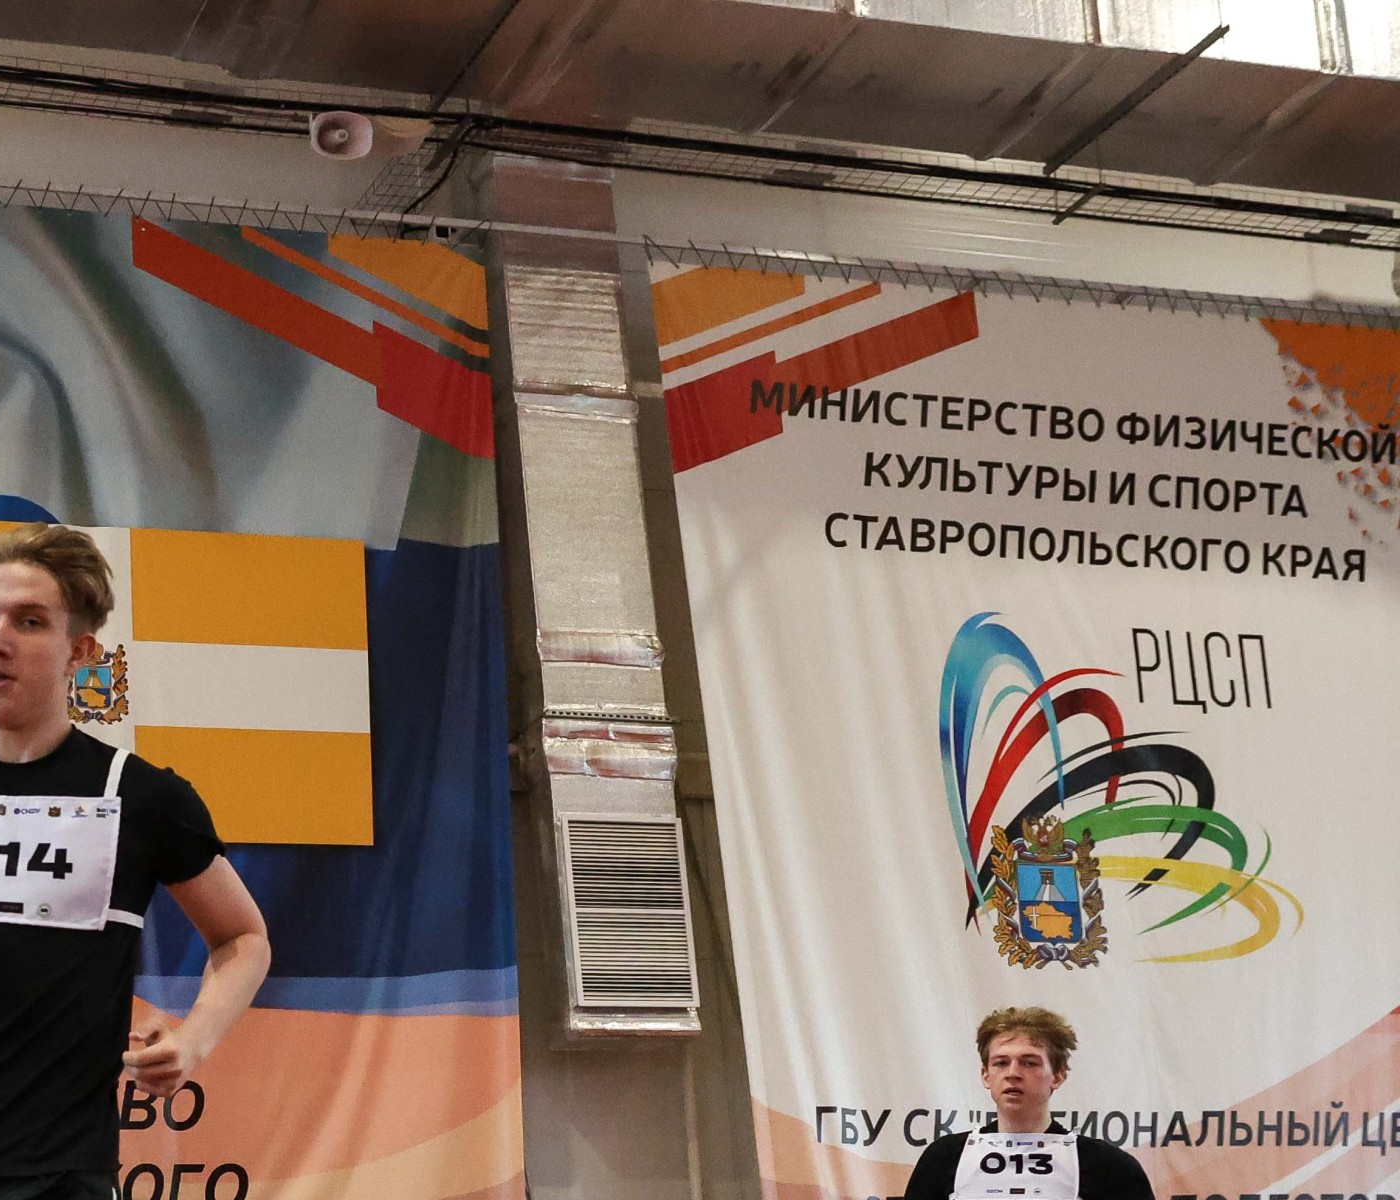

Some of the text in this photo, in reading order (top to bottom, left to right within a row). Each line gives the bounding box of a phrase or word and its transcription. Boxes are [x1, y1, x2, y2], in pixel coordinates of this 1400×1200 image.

[748, 380, 1397, 464] МИНИСТЕРСТВО ФИЗИЧЕСКОЙ
[863, 452, 1308, 518] КУЛЬТУРЫ И СПОРТА
[825, 512, 1366, 582] СТАВРОПОЛЬСКОГО КРАЯ
[1131, 627, 1273, 714] РЦСП
[815, 1106, 891, 1147] ГБУ
[903, 1108, 958, 1147] СК
[980, 1151, 1053, 1175] 013
